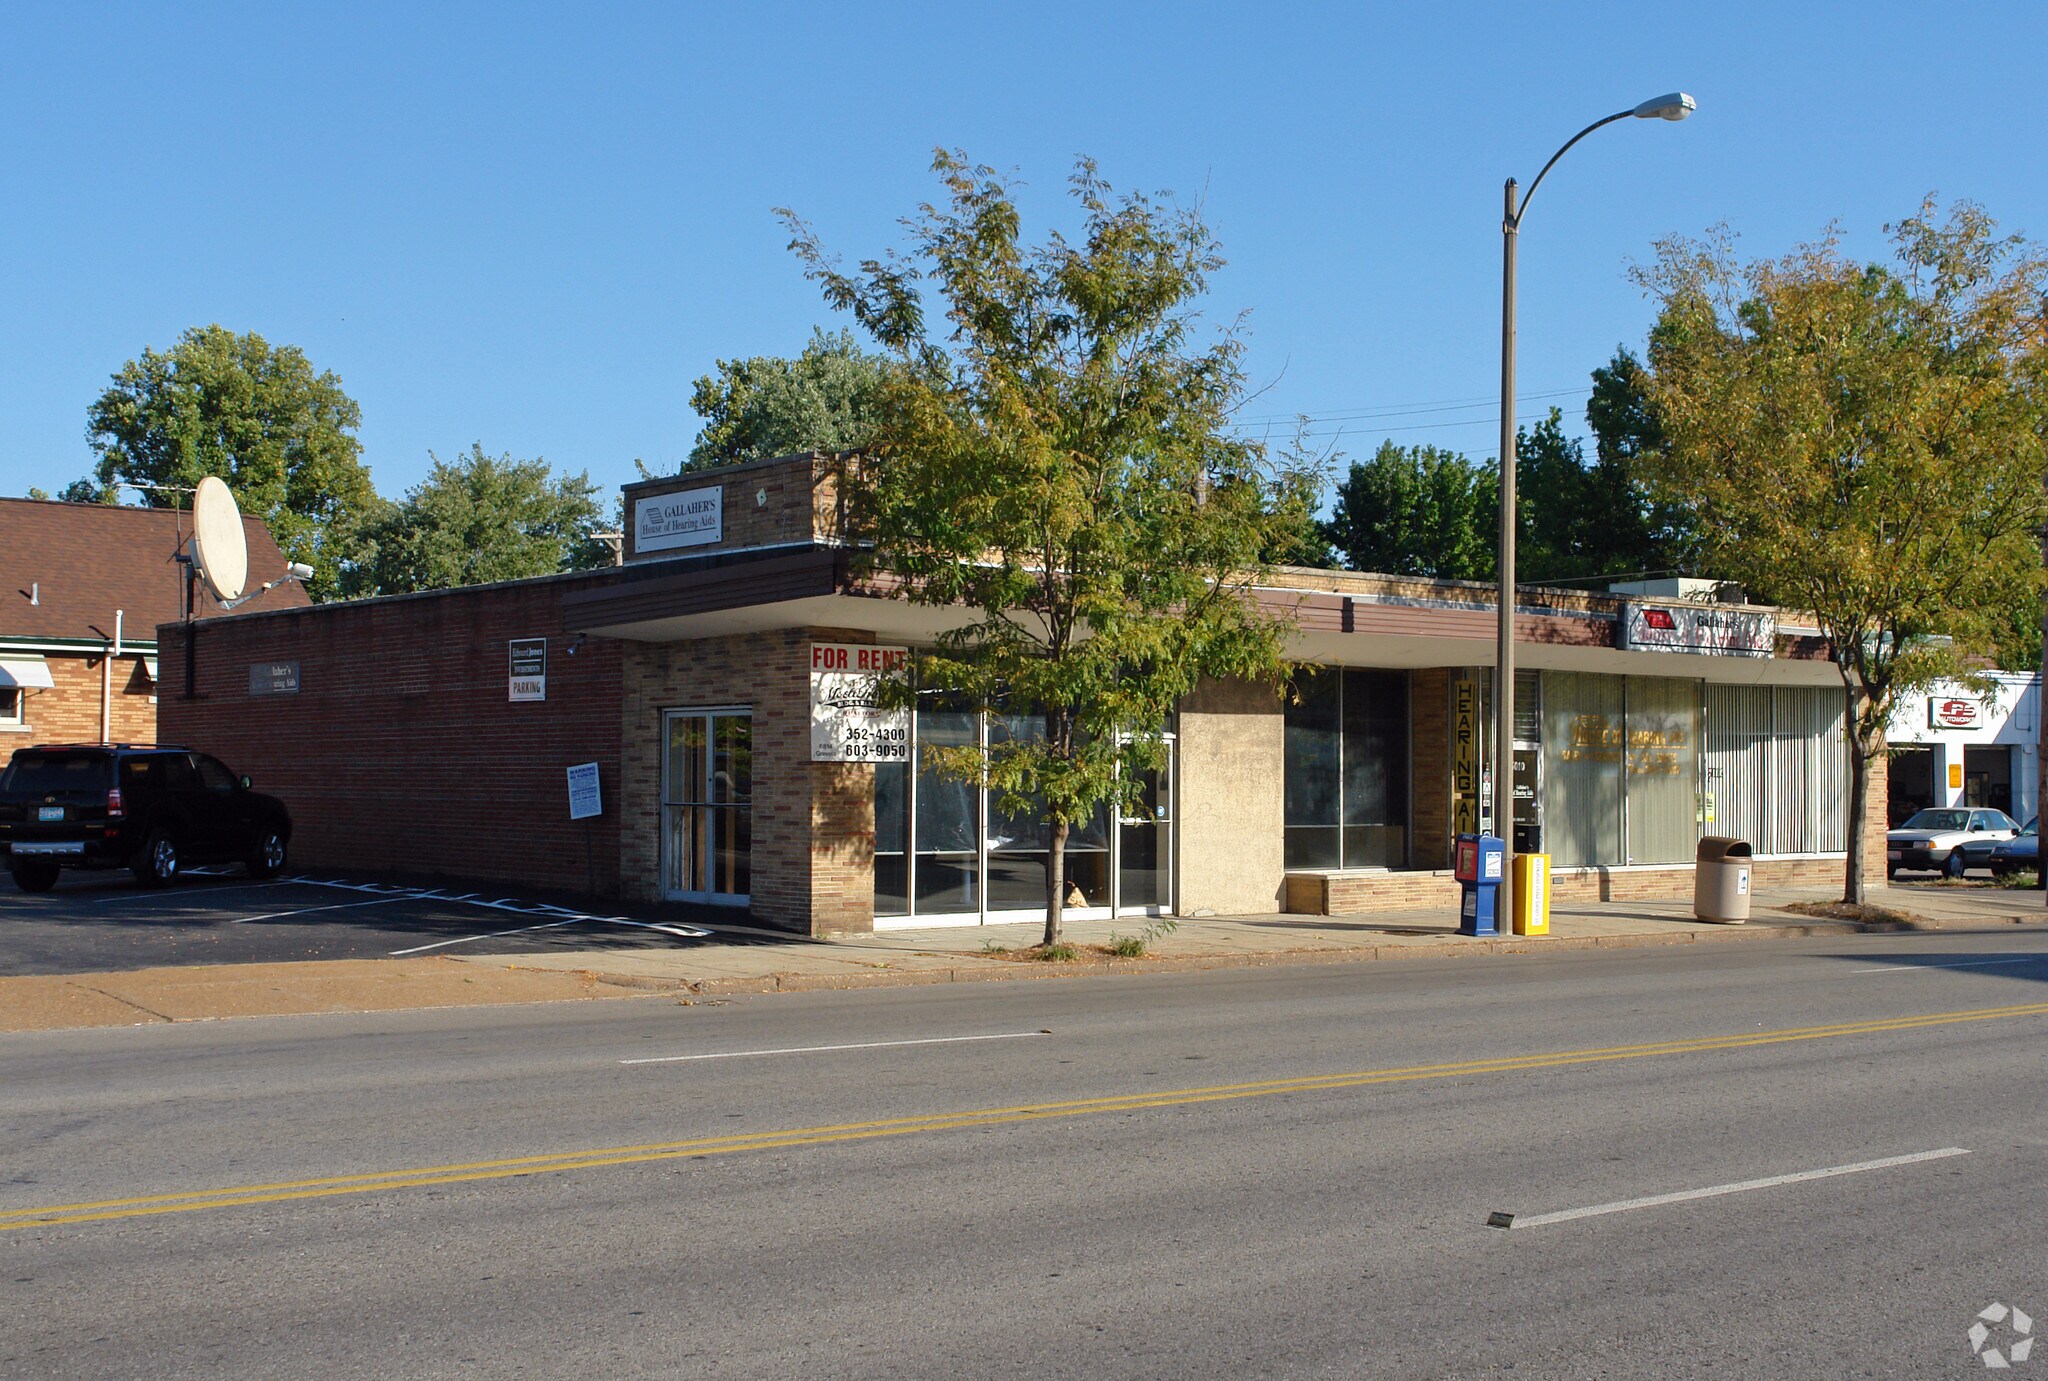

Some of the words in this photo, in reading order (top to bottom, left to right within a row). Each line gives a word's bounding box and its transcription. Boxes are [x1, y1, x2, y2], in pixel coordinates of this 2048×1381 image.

[664, 500, 716, 518] GALLAHER'S
[642, 523, 662, 535] House
[663, 520, 671, 532] of
[672, 518, 699, 530] Hearing
[701, 514, 716, 526] Aids
[1697, 615, 1740, 630] Gallaher's
[812, 647, 848, 669] FOR
[858, 649, 906, 671] RENT
[513, 680, 541, 694] PARKING
[846, 728, 905, 741] 352-4300
[1458, 683, 1471, 791] HEARING
[846, 744, 906, 757] 603-9050
[569, 765, 595, 775] WARNING
[1512, 761, 1526, 771] 010
[1458, 802, 1470, 833] AI
